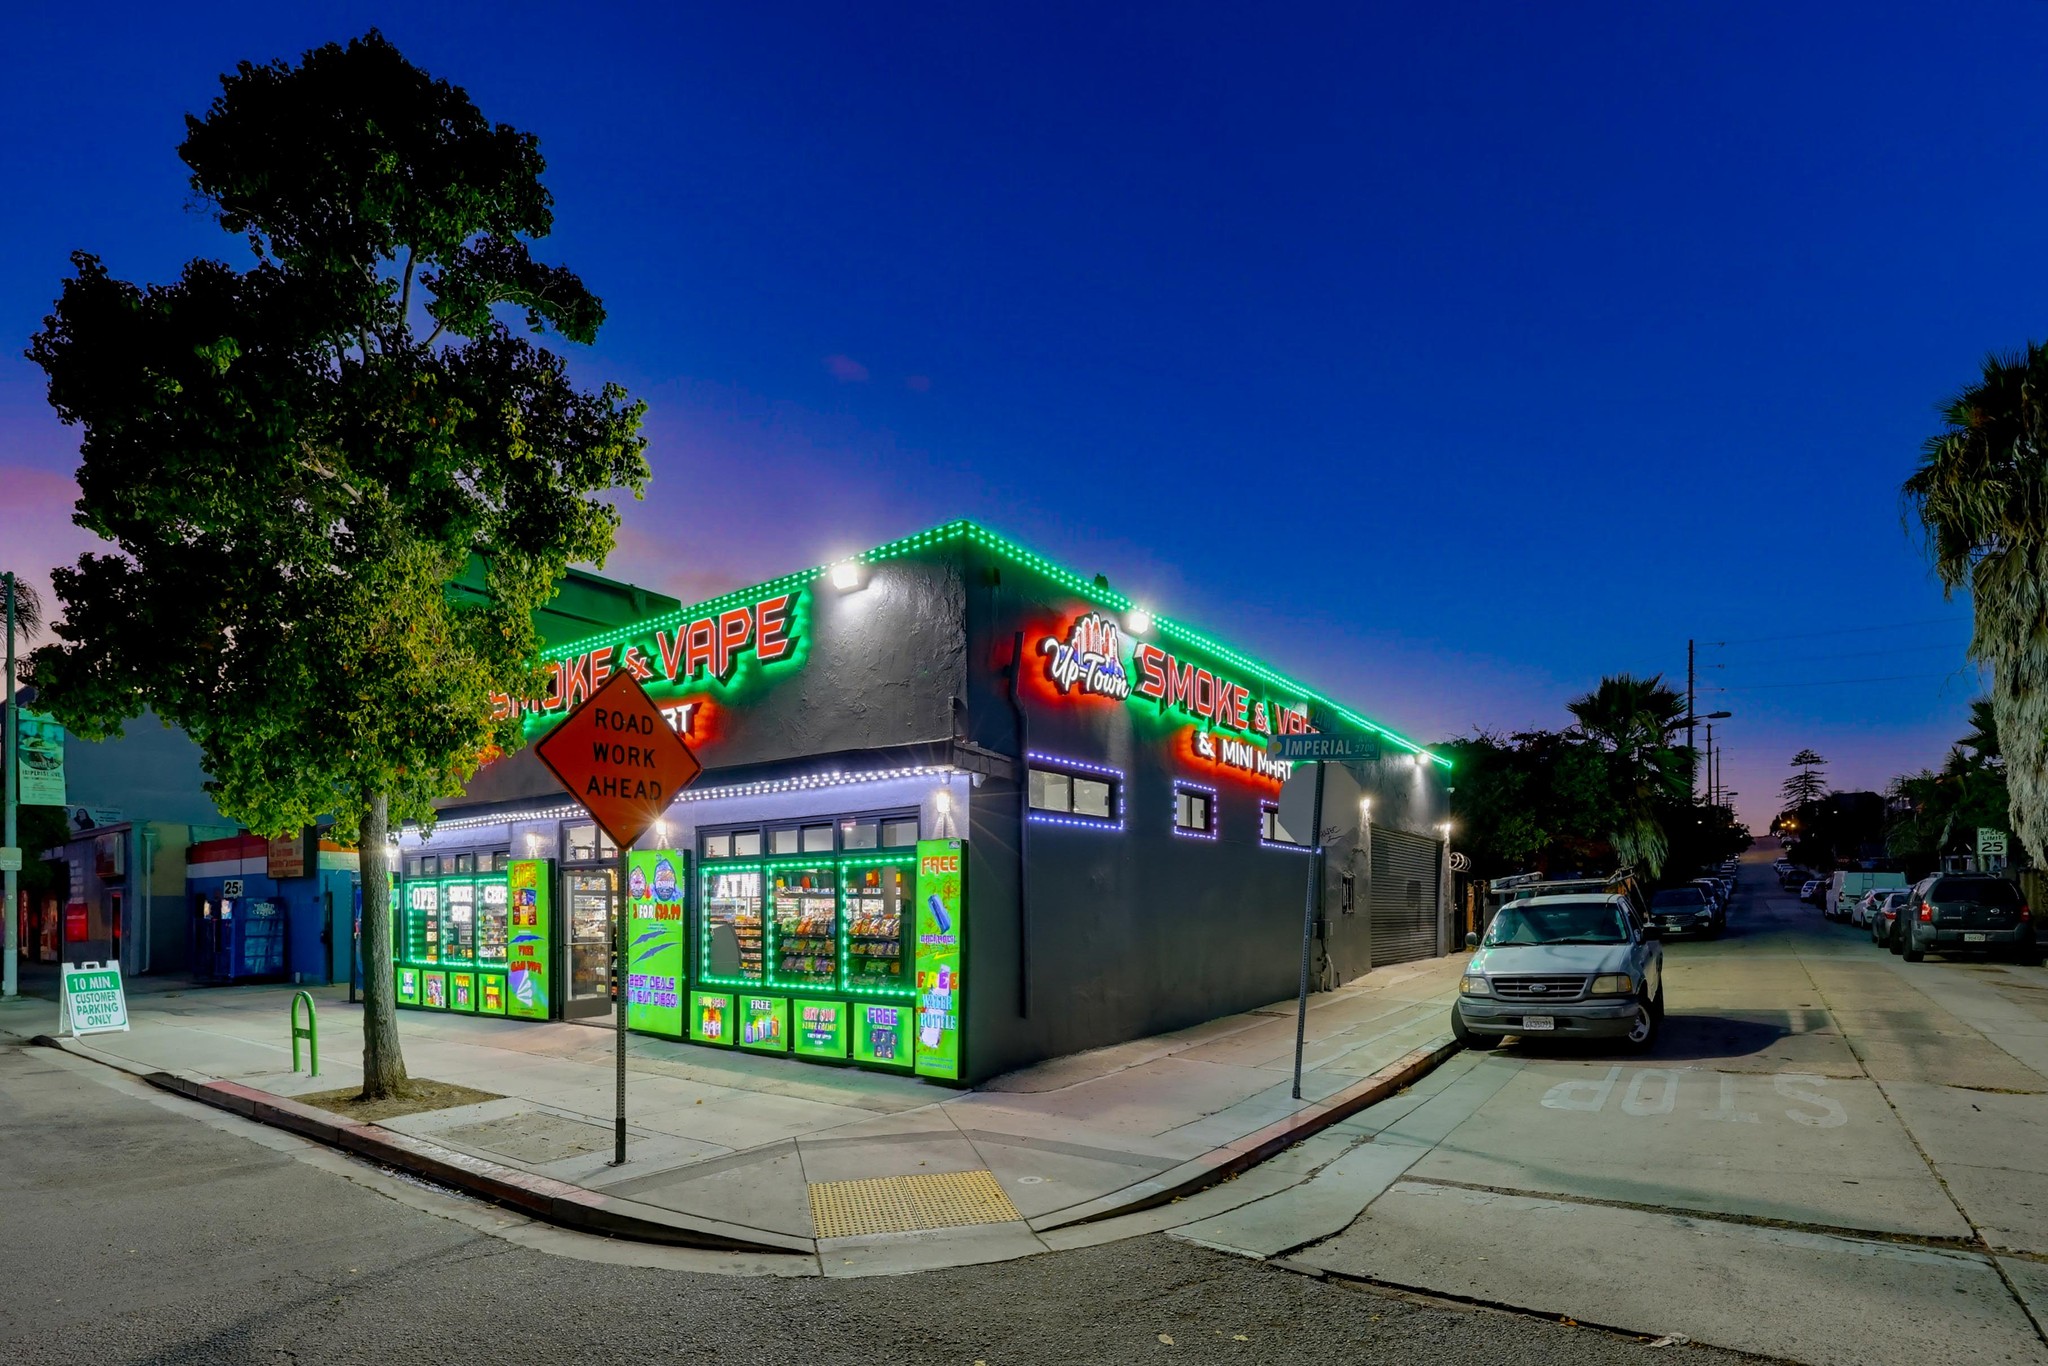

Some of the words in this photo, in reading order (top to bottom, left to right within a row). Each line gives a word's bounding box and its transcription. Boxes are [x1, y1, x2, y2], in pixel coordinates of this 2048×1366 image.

[623, 646, 654, 682] &
[656, 594, 789, 681] VAPE
[1140, 643, 1250, 730] SMOKE
[1254, 701, 1272, 735] &
[1274, 702, 1321, 735] VA
[595, 708, 654, 735] ROAD
[660, 703, 693, 733] RT
[593, 742, 656, 768] WORK
[1199, 732, 1215, 758] &
[1223, 739, 1253, 769] MINI
[1284, 738, 1352, 756] IMPERIAL
[586, 775, 662, 801] AHEAD
[1982, 842, 2004, 852] 25
[921, 855, 959, 877] FREE
[717, 873, 758, 898] ATM
[412, 887, 437, 910] OPE
[639, 904, 654, 919] FOR
[73, 978, 86, 990] 10
[89, 976, 114, 989] MIN.
[917, 971, 959, 990] FREE
[75, 991, 116, 1004] CUSTOMER
[76, 1002, 118, 1015] PARKING
[751, 999, 771, 1010] FREE
[87, 1014, 112, 1026] ONLY
[867, 1007, 898, 1026] FREE
[1541, 1064, 1848, 1128] STOP
